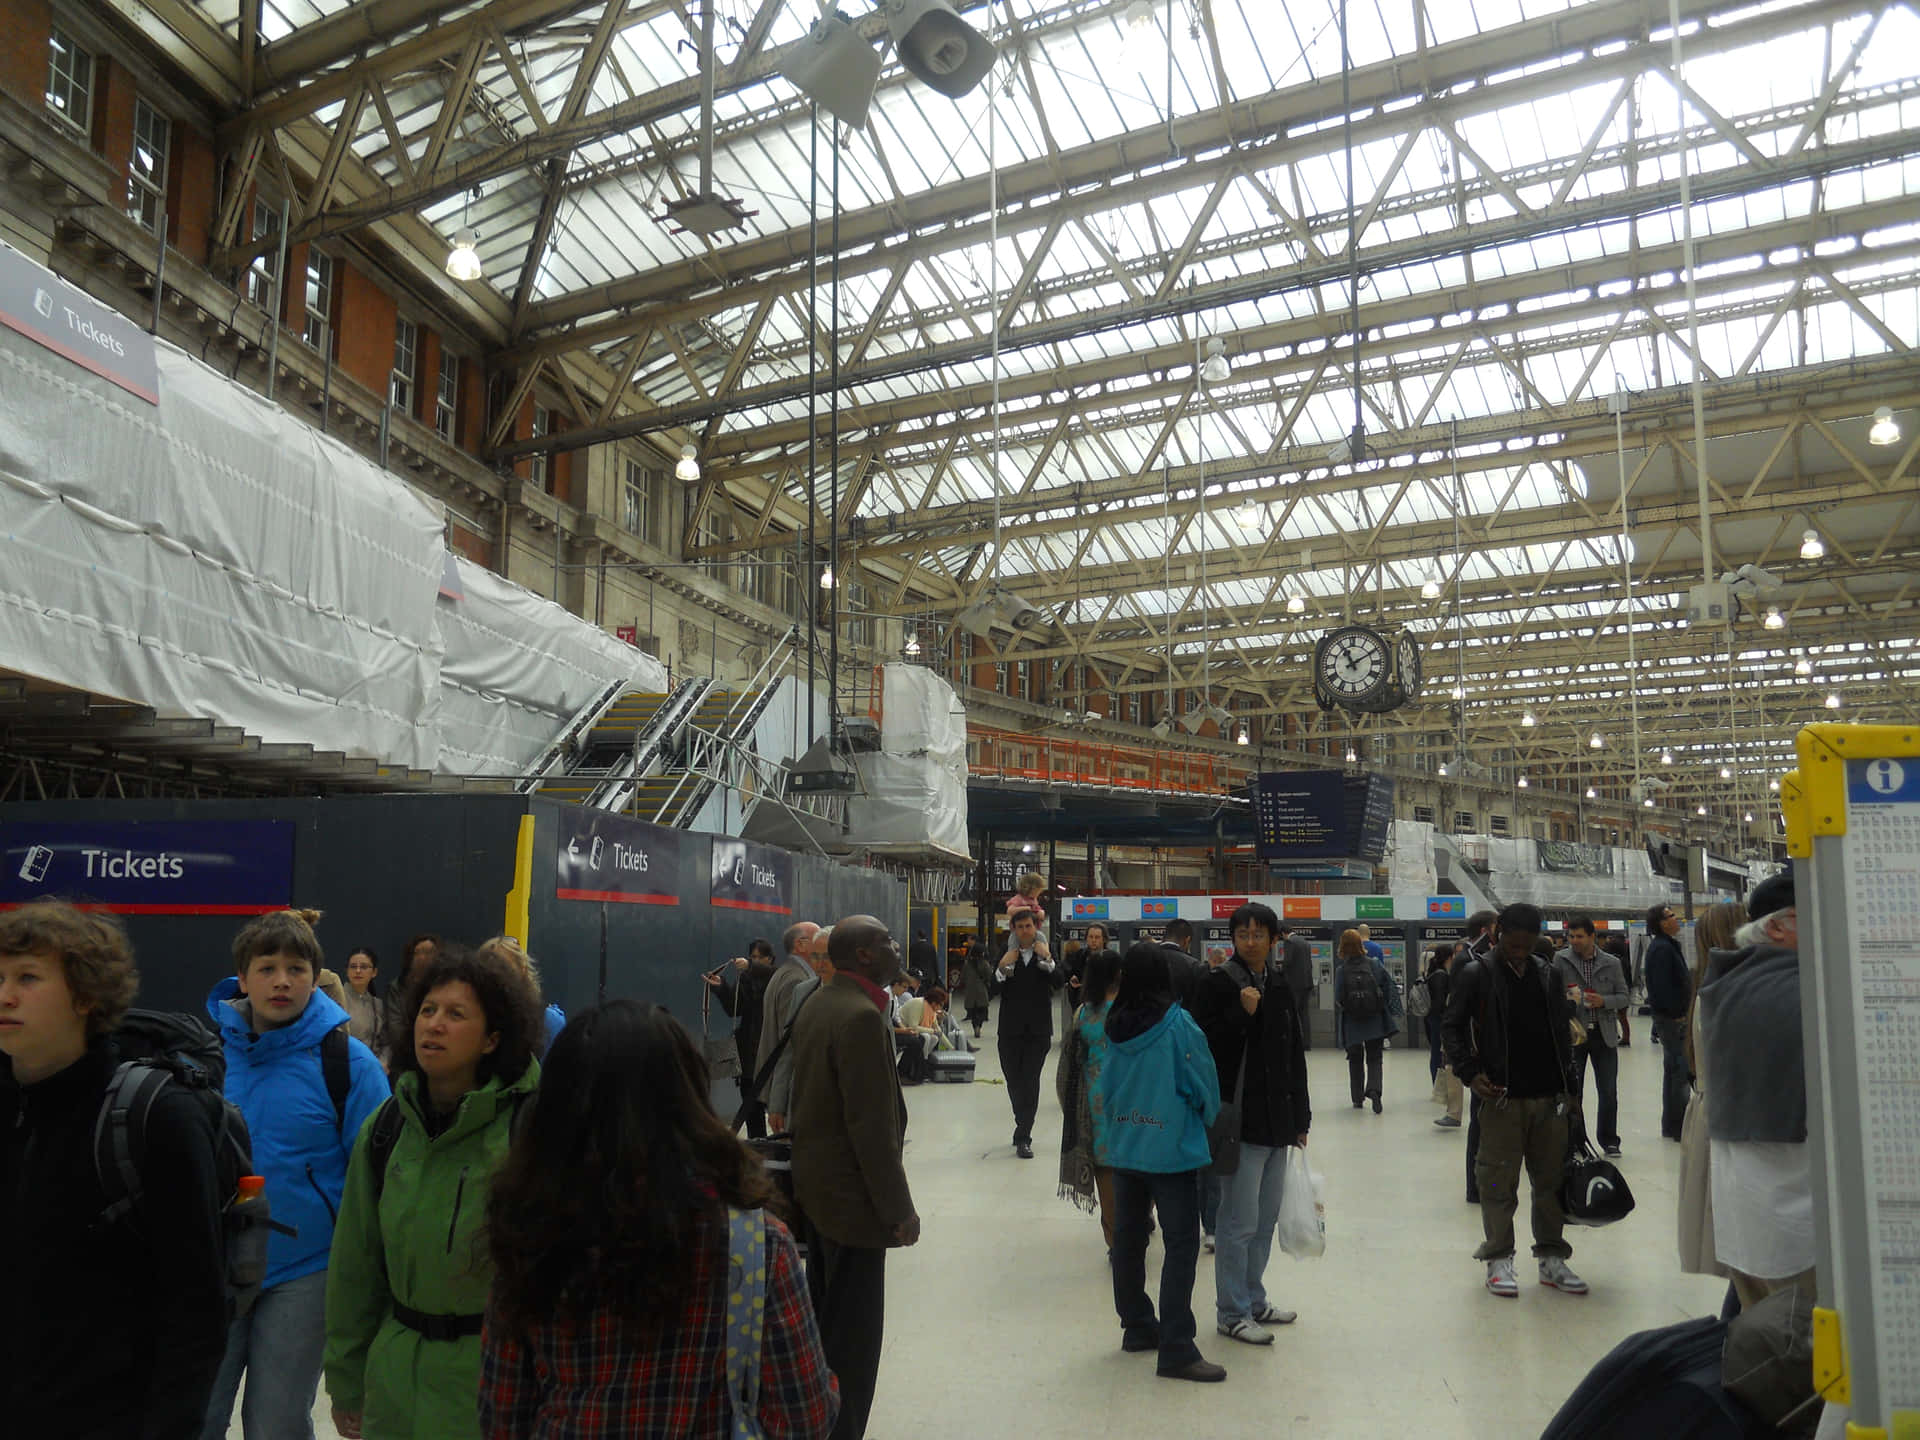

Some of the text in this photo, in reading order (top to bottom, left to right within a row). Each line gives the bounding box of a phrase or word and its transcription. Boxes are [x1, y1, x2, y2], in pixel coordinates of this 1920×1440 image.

[64, 306, 125, 357] Tickets
[82, 849, 184, 878] Tickets
[613, 843, 649, 872] Tickets
[751, 864, 776, 888] Tickets
